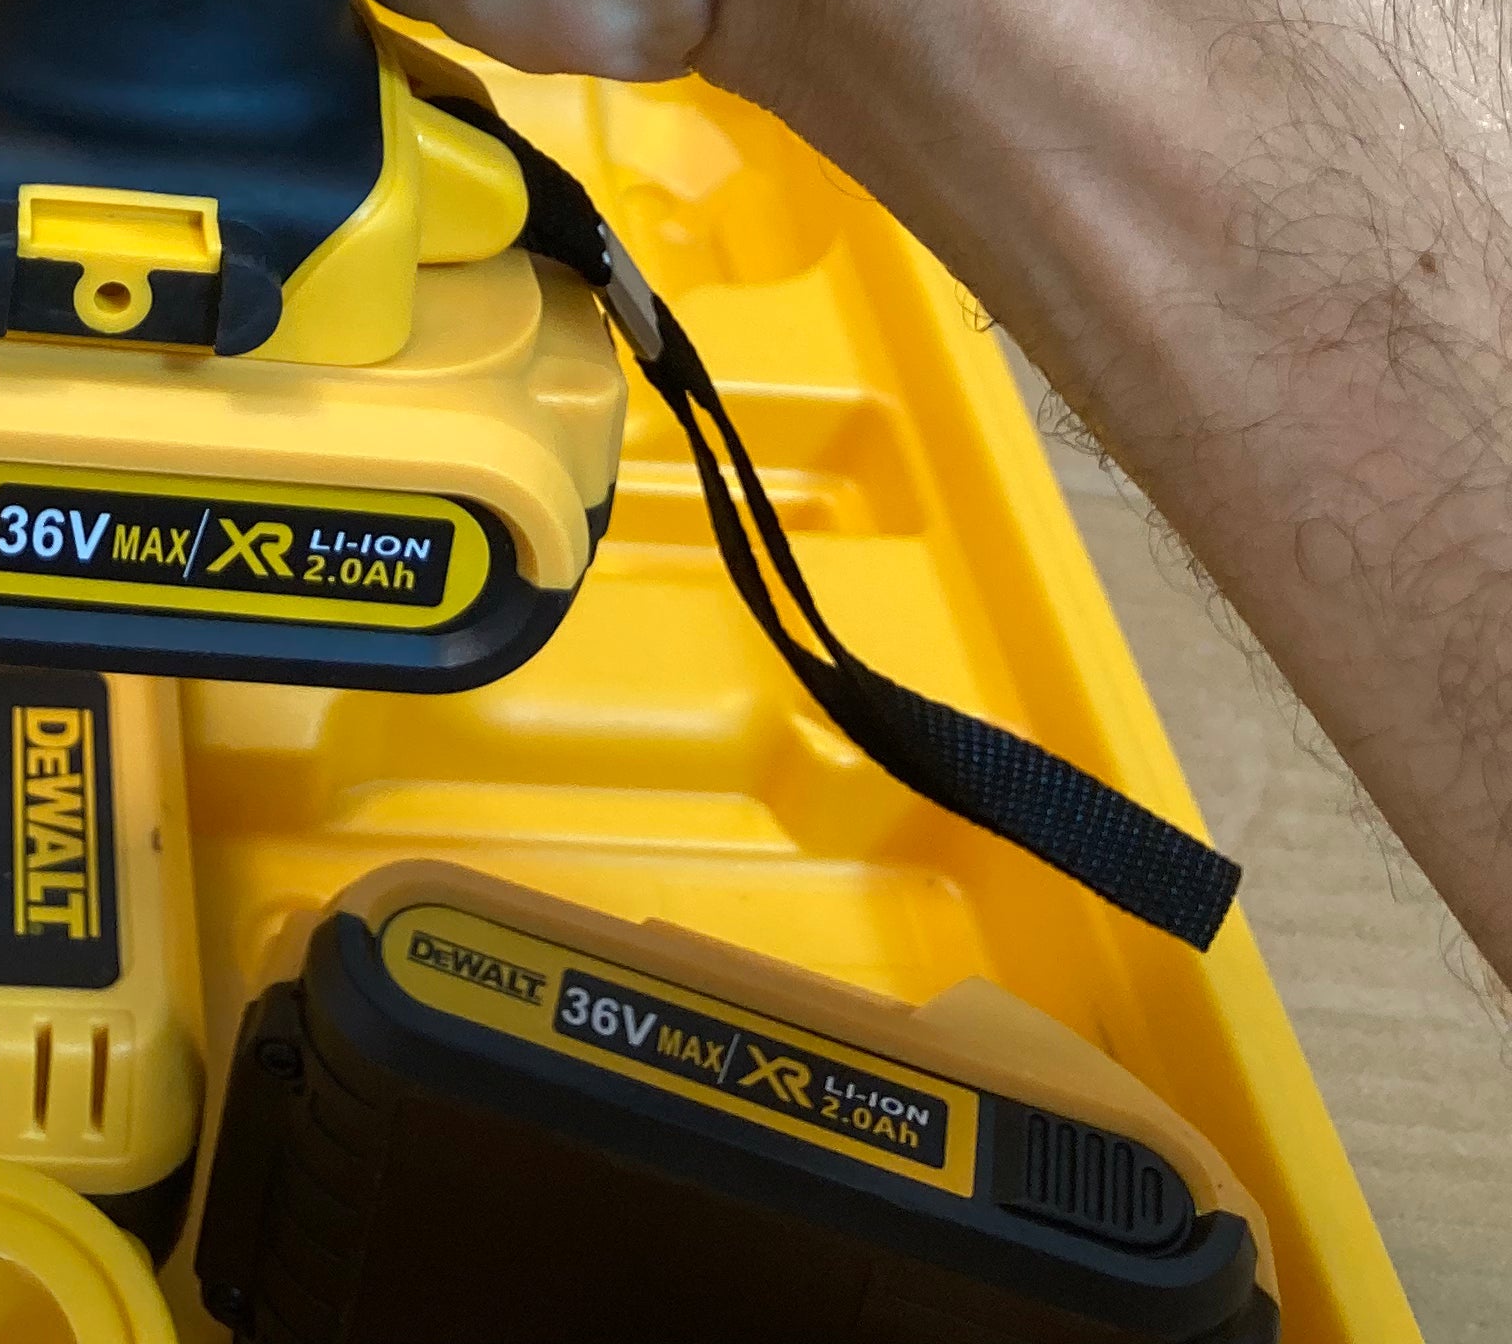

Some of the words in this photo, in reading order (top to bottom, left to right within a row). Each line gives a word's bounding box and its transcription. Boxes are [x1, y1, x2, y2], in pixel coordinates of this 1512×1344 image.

[310, 528, 431, 559] LI-ION
[302, 554, 416, 590] 2.0Ah
[560, 986, 658, 1047] 36V
[819, 1096, 920, 1148] 2.0Ah
[822, 1074, 930, 1127] LI-ION
